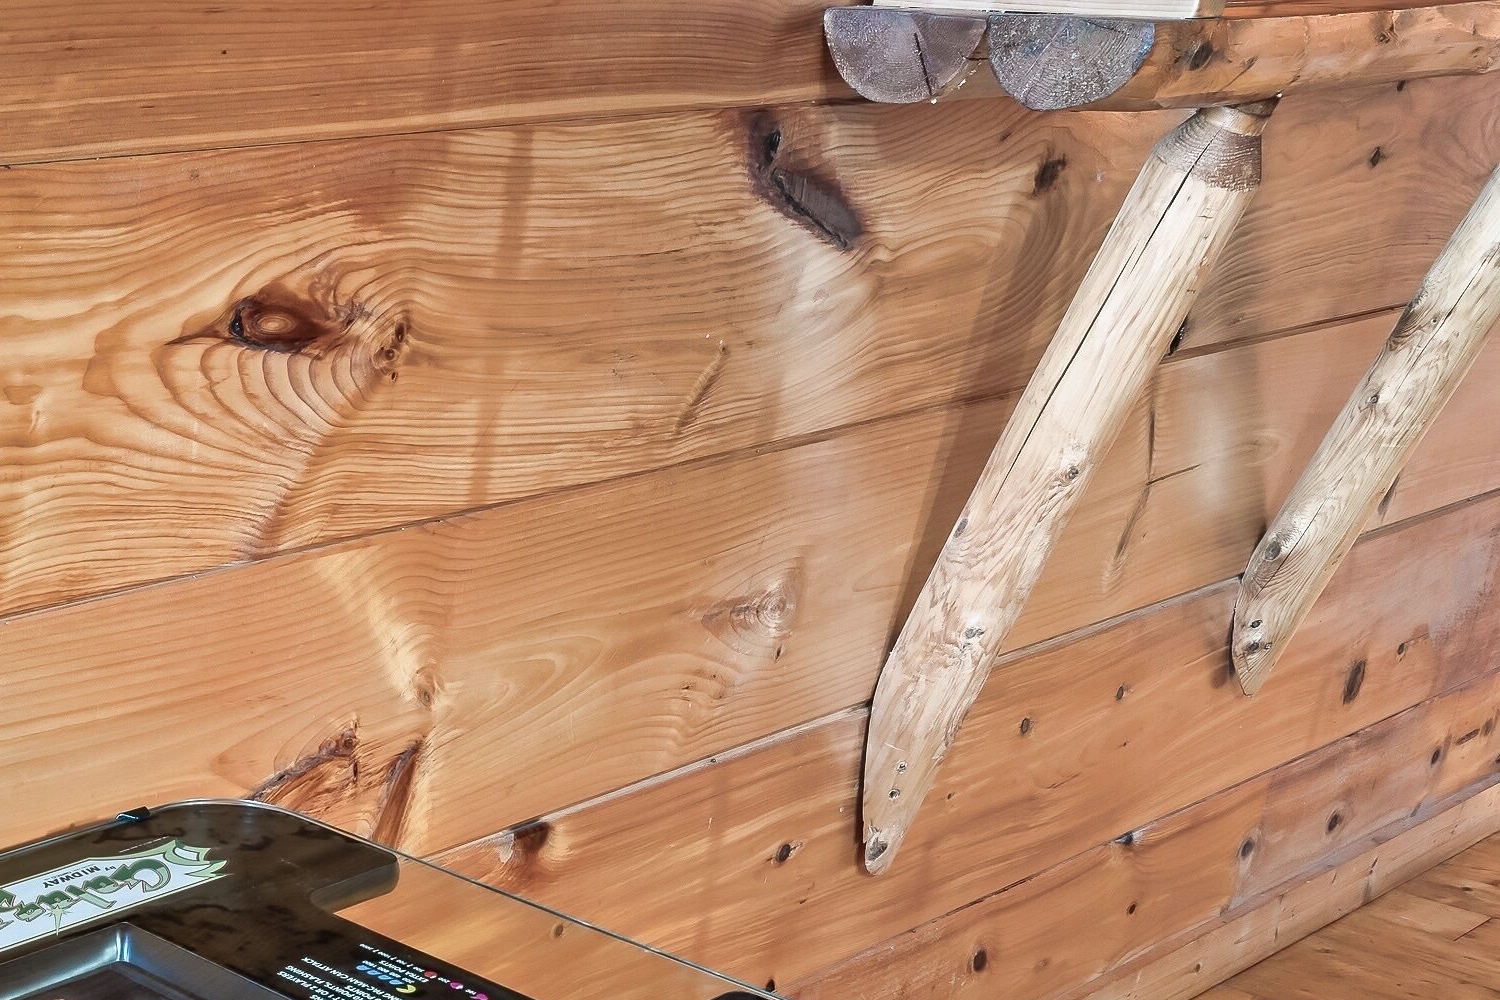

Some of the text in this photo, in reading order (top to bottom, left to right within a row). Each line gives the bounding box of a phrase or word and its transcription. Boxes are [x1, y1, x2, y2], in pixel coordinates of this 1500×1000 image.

[43, 865, 100, 888] MIDWAY
[301, 957, 333, 971] ATTACK
[379, 960, 407, 974] POINTS
[277, 971, 312, 988] PLAYERS
[285, 965, 325, 984] FLASHING
[329, 969, 349, 980] CAN
[344, 985, 375, 1000] POINTS
